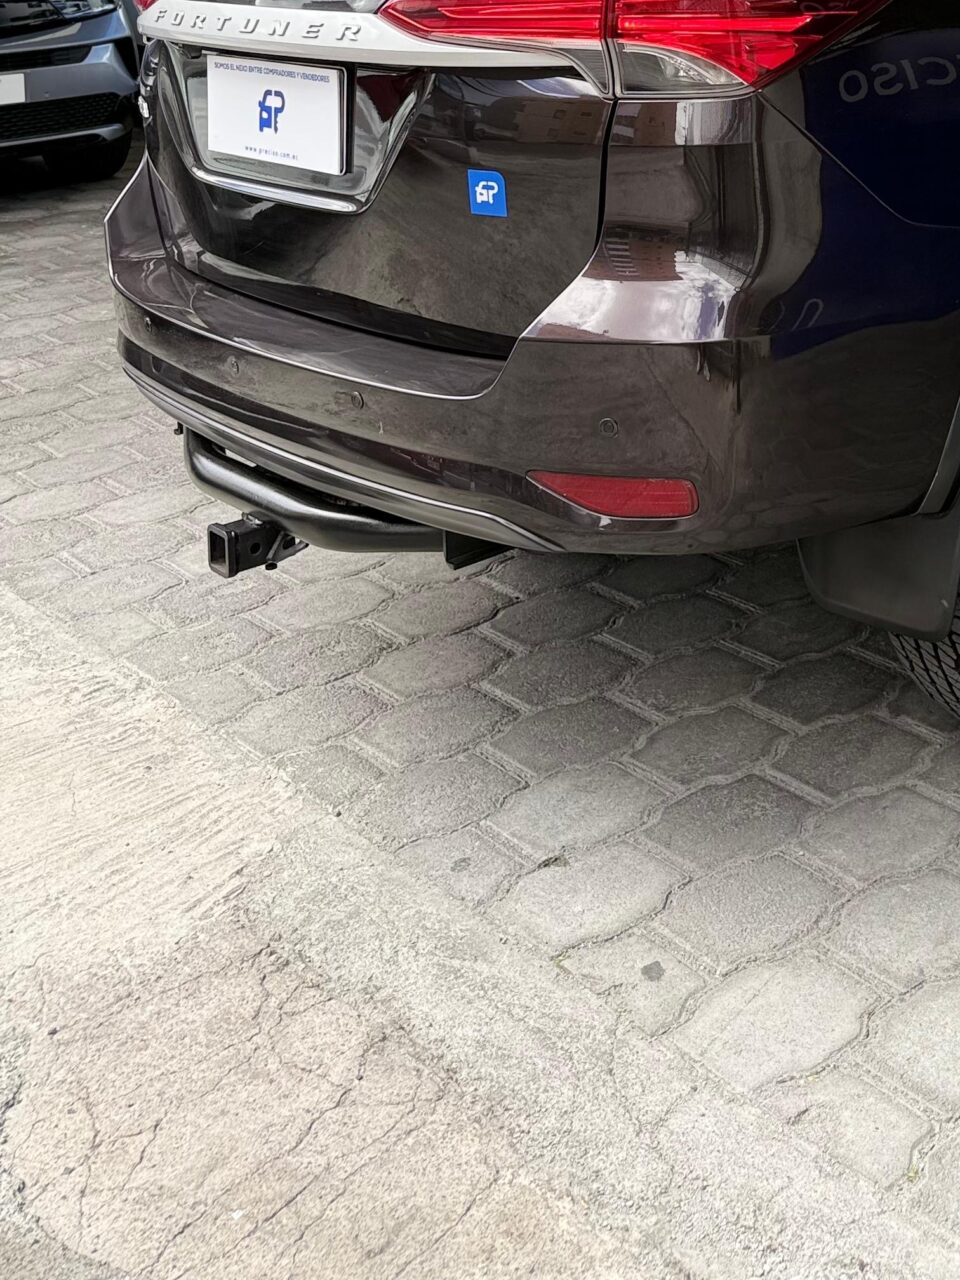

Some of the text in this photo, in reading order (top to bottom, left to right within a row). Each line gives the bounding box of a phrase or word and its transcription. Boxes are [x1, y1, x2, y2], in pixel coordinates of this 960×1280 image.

[152, 8, 361, 42] FORTUNER
[214, 61, 229, 70] SOMOS
[248, 66, 262, 74] ENTRE
[263, 67, 296, 79] COMPRADORES
[300, 72, 330, 83] VENDEDORES
